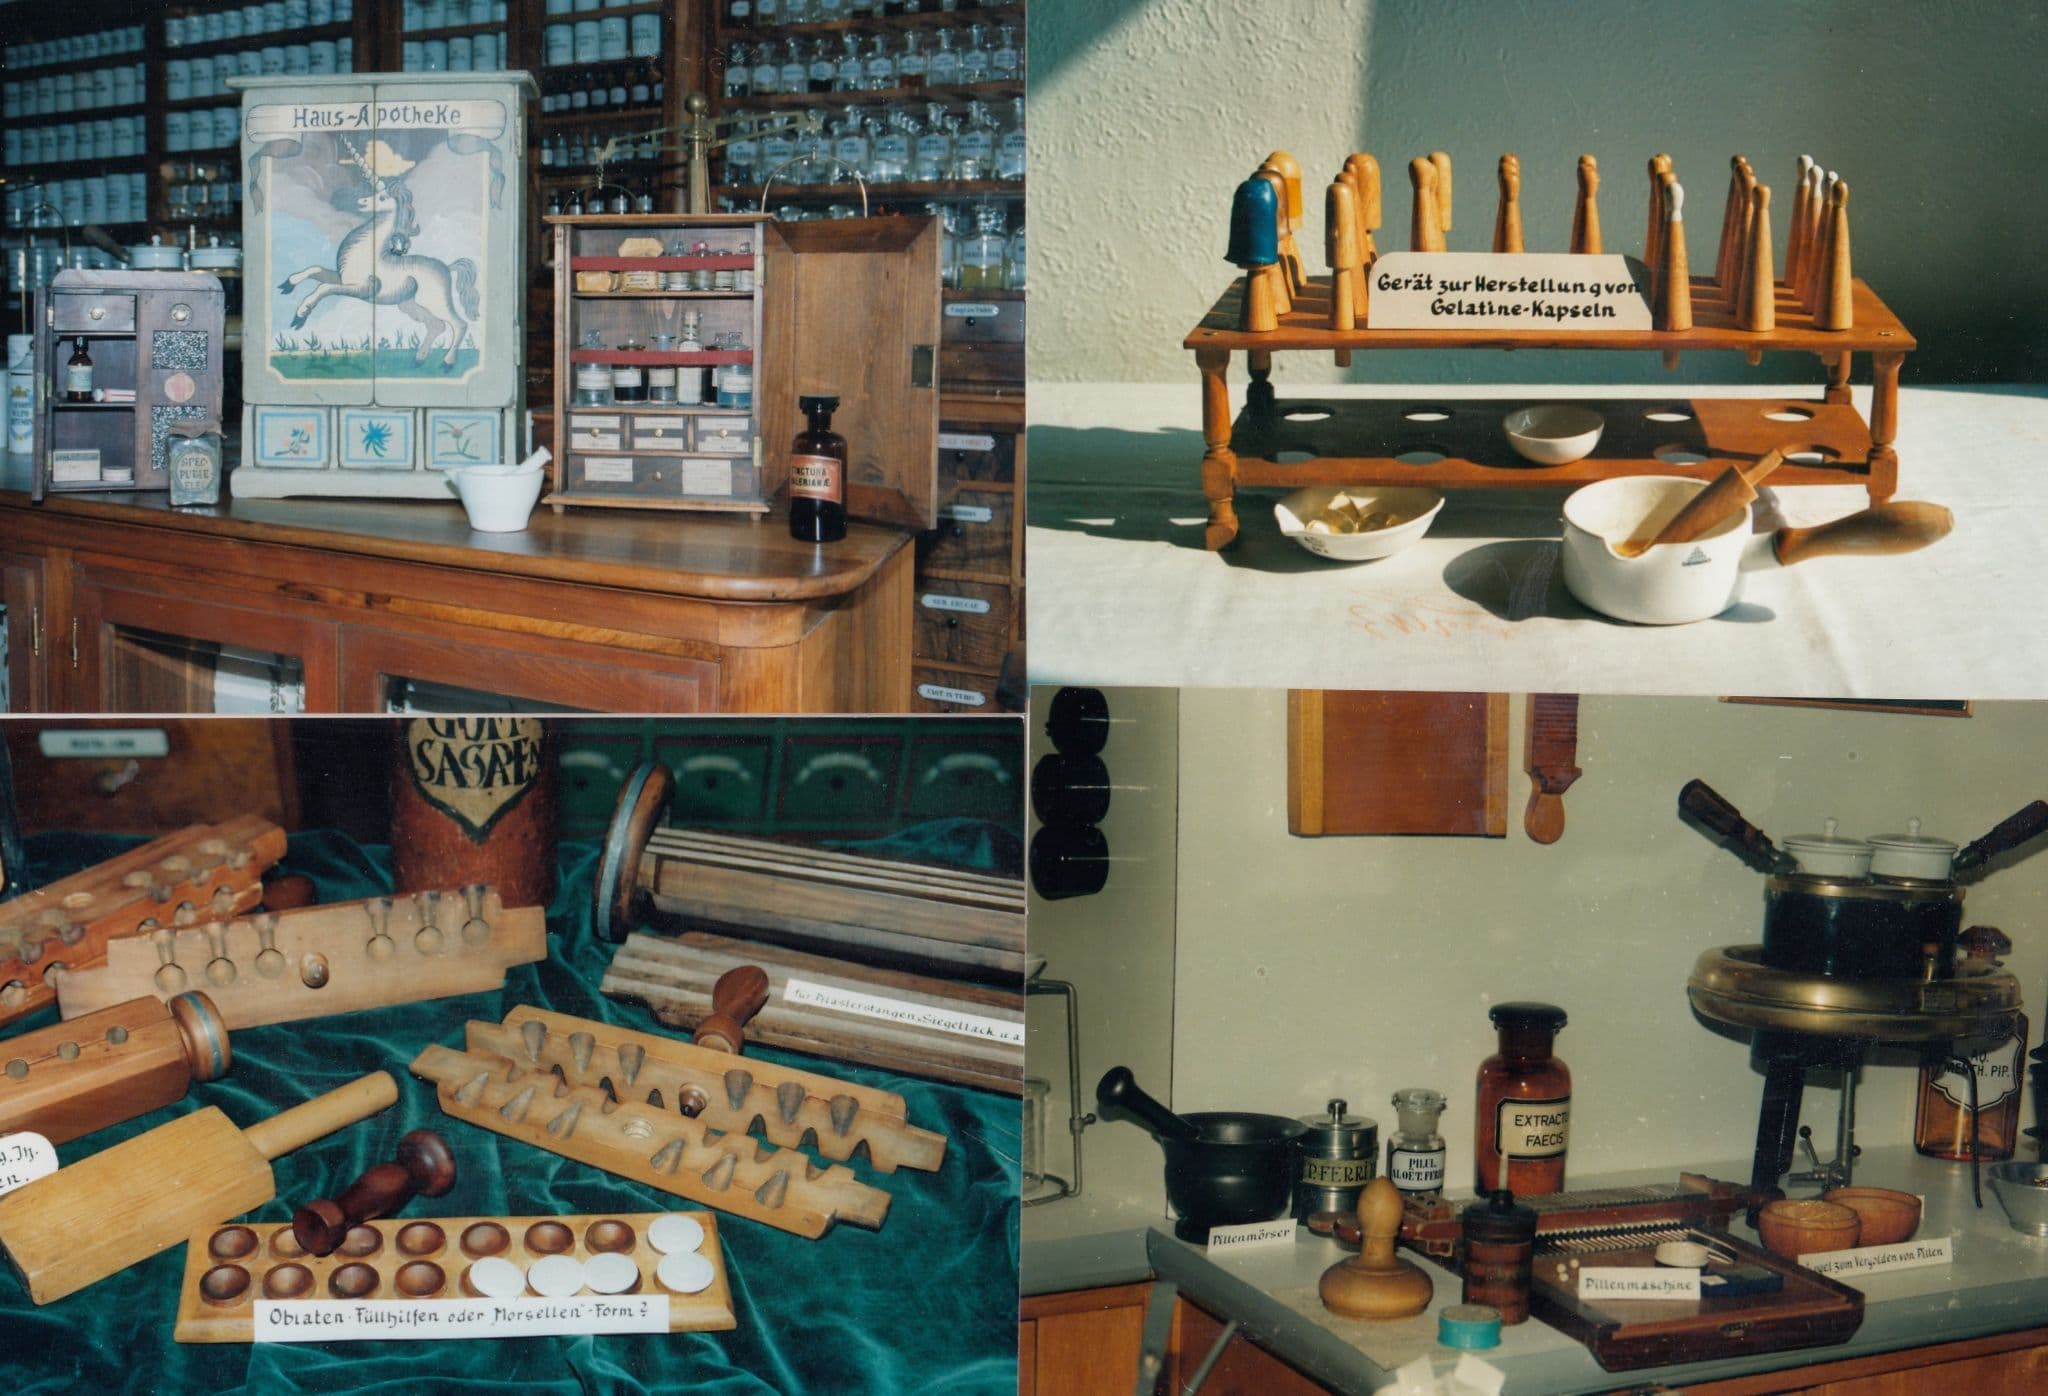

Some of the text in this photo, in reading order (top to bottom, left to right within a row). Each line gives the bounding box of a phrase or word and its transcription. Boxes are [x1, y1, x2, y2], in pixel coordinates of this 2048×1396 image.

[1377, 272, 1641, 298] Gerät zur Herstellung von
[1430, 297, 1616, 322] Gelatine-Kapseln
[1990, 1065, 2010, 1078] PIP.
[1526, 1131, 1564, 1147] FAECIS
[1213, 1229, 1290, 1246] Pillenmörser
[1584, 1277, 1693, 1294] Pillenmaschine
[447, 1308, 485, 1323] oder
